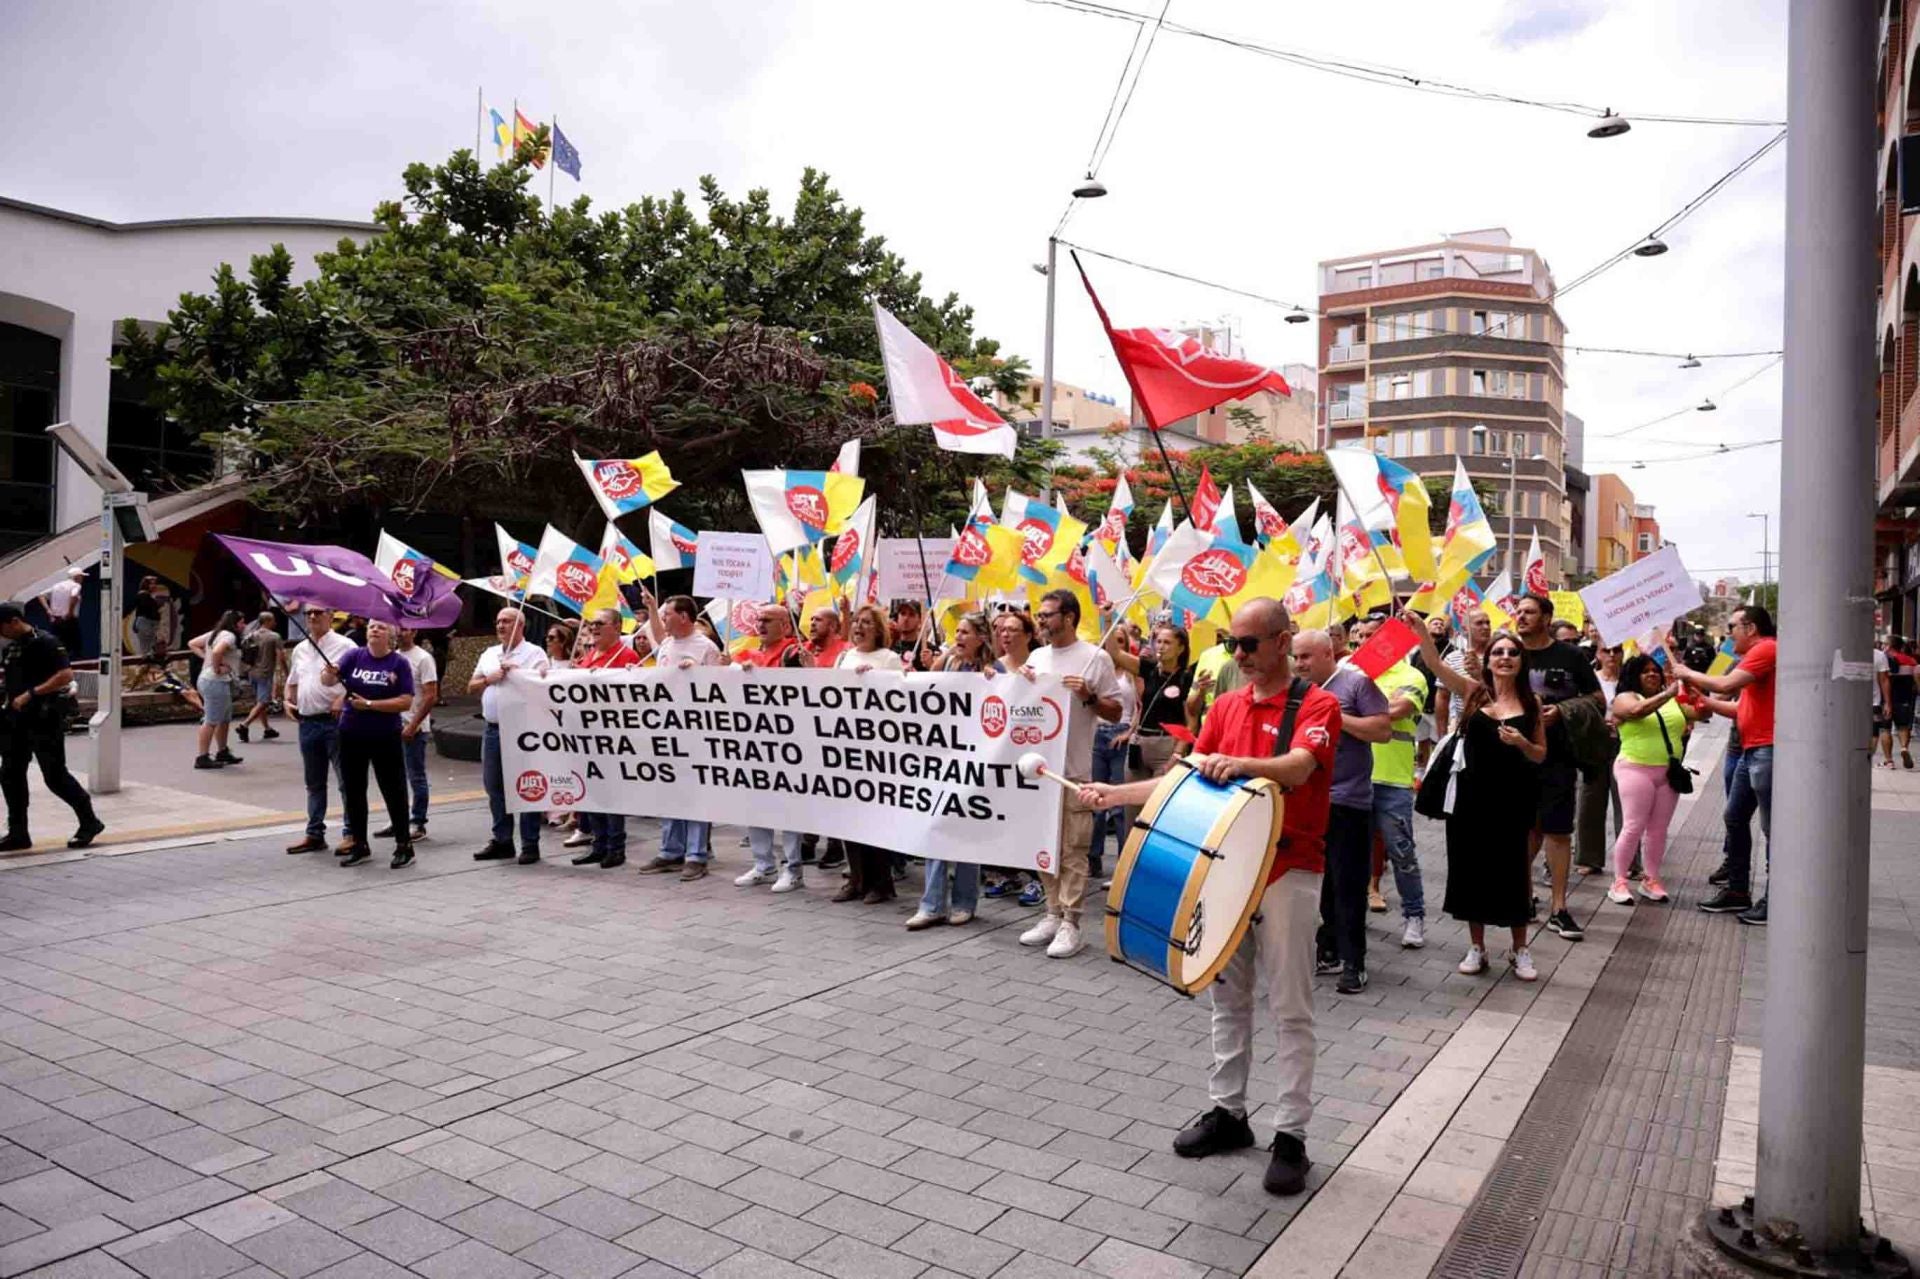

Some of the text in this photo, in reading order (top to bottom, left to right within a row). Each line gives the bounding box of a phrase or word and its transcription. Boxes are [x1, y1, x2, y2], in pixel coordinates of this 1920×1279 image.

[600, 461, 627, 481] UGT
[1023, 524, 1049, 547] UGT
[564, 565, 593, 587] UGT
[1203, 555, 1240, 581] UGT
[351, 667, 380, 681] UGT
[549, 682, 972, 717] CONTRA LA EXPLOTACIÓN
[983, 702, 1005, 718] UGT
[1010, 705, 1044, 718] FeSMC
[550, 708, 976, 752] Y PRECARIEDAD LABORAL.
[517, 731, 637, 757] CONTRA
[652, 736, 690, 758] EL
[704, 738, 803, 765] TRATO
[520, 775, 544, 789] UGT
[586, 760, 1006, 821] A LOS TRABAJADORES/AS.
